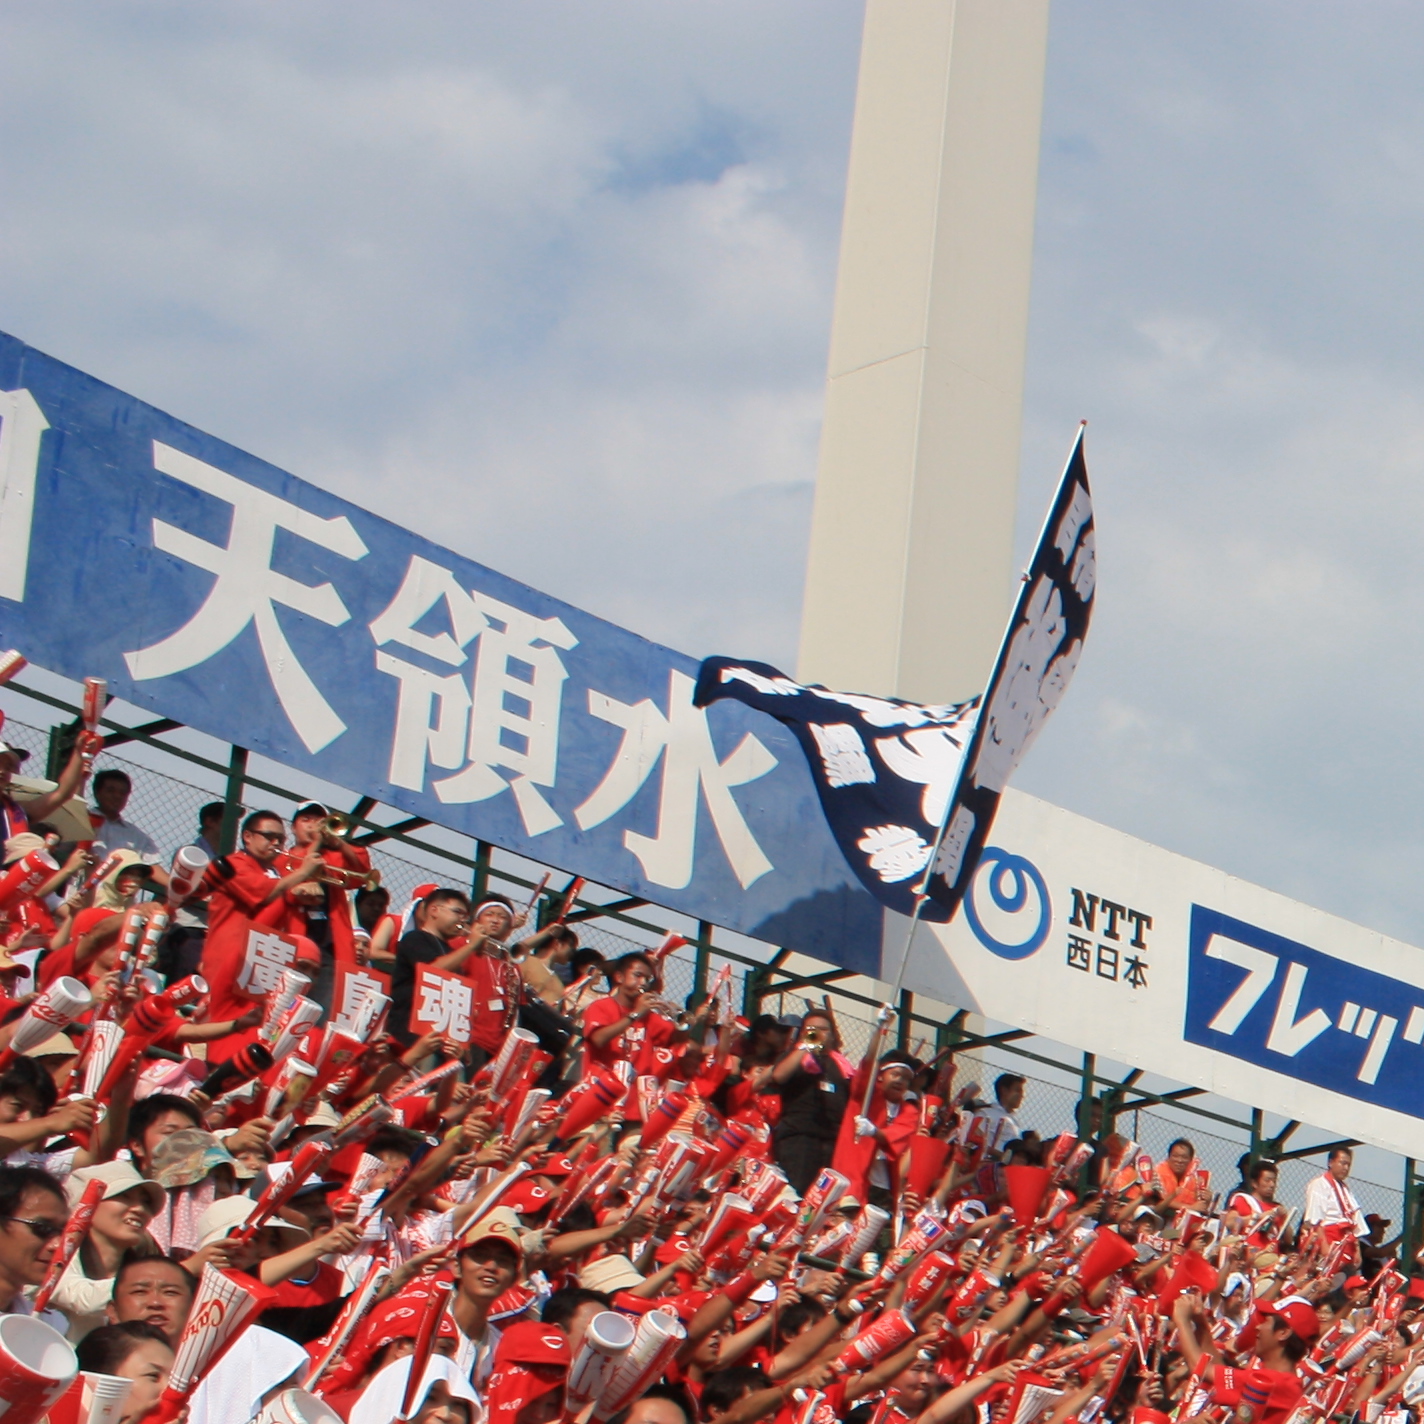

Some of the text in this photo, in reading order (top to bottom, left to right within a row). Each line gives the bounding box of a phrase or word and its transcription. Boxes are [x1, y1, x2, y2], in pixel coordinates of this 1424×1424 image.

[0, 386, 779, 891] 天領水
[1069, 887, 1153, 950] NTT
[1066, 933, 1149, 990] 西日本
[416, 974, 475, 1042] 魂
